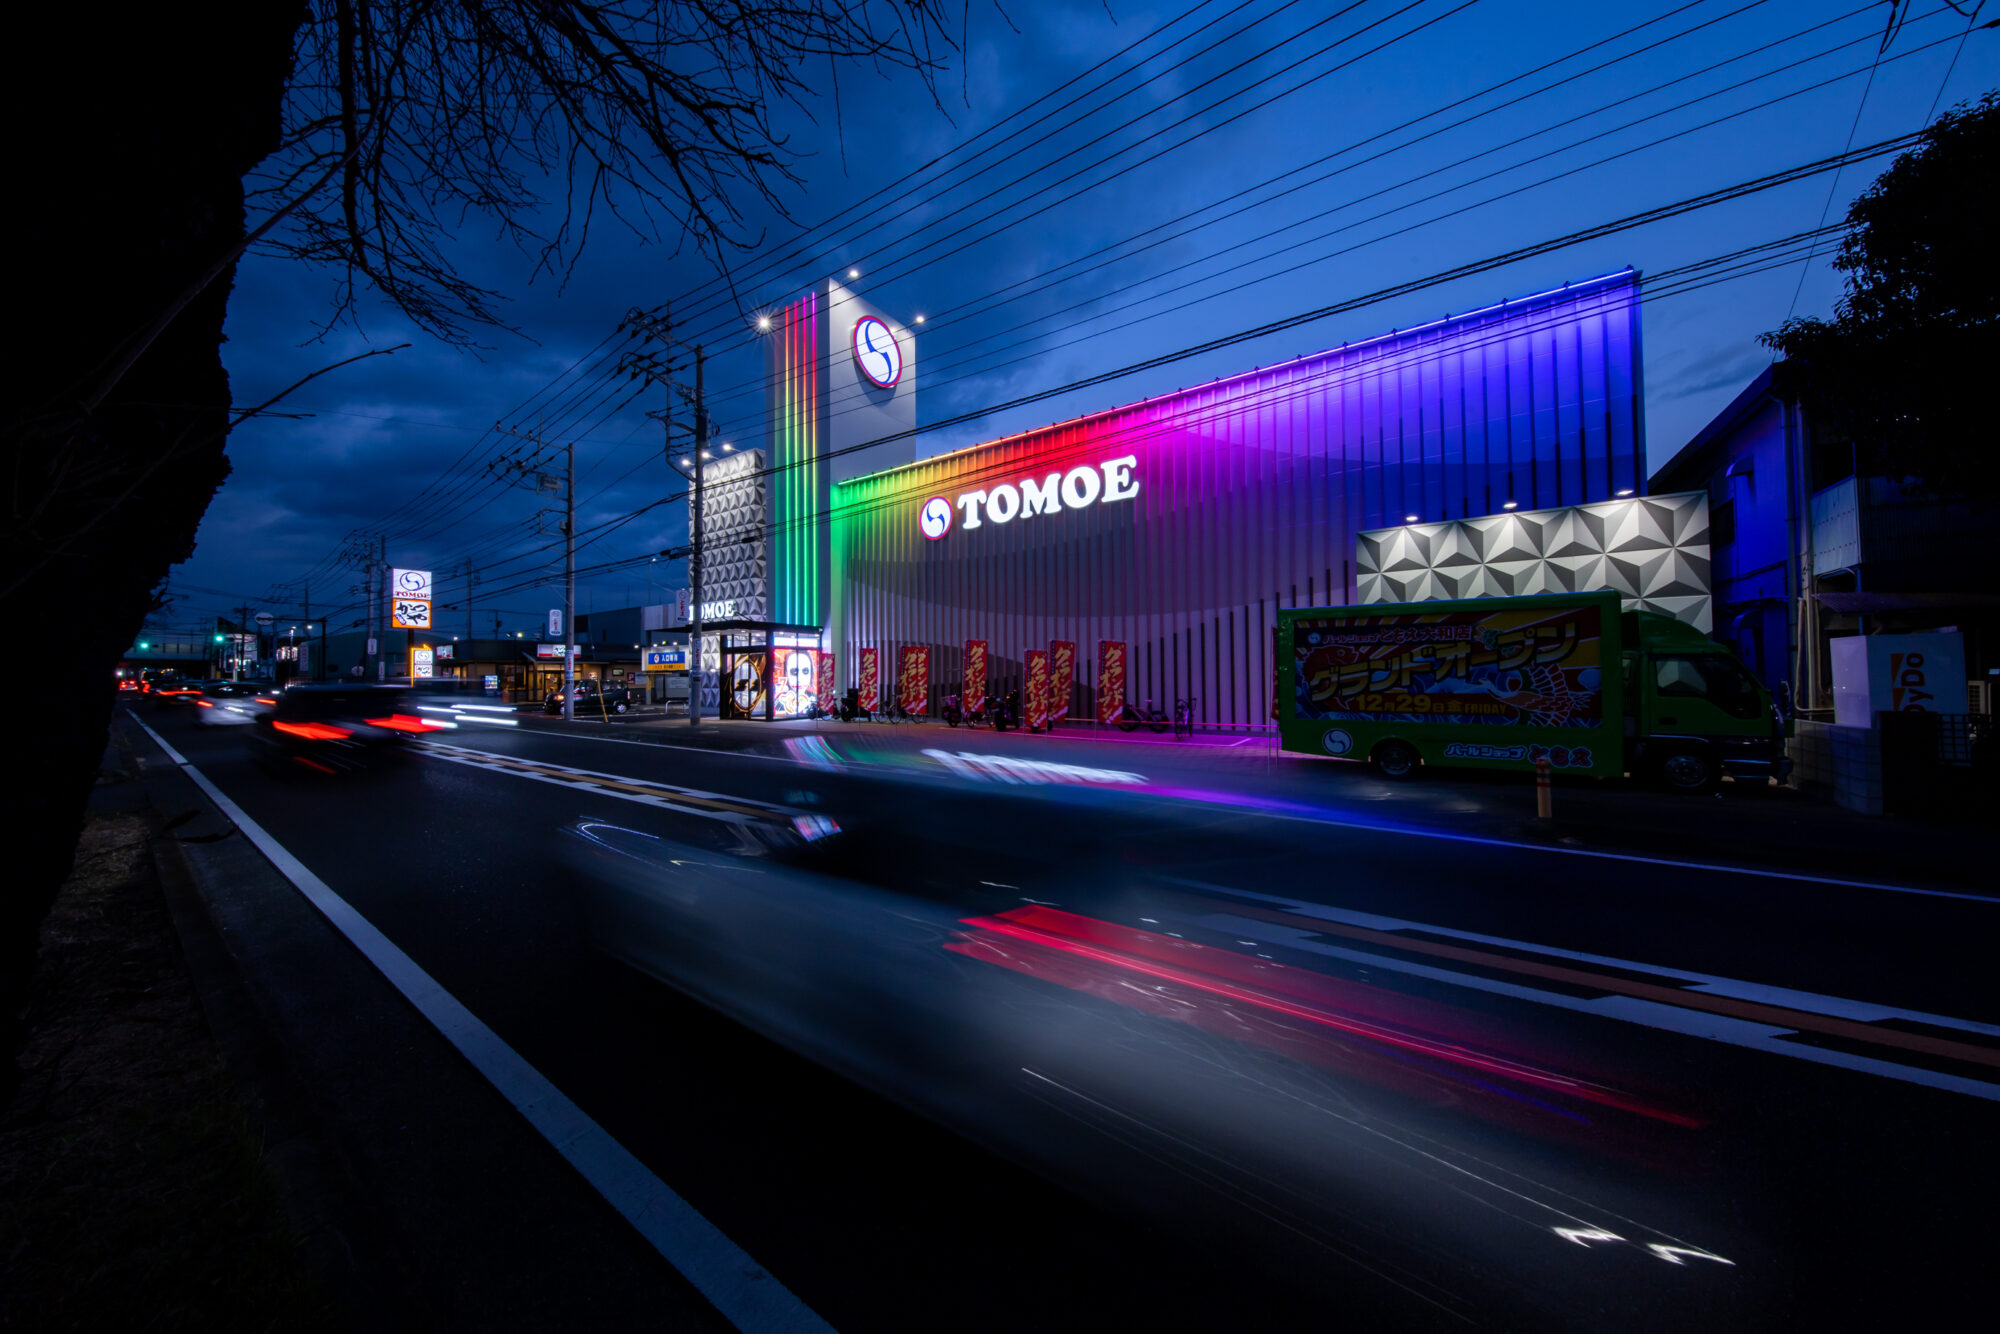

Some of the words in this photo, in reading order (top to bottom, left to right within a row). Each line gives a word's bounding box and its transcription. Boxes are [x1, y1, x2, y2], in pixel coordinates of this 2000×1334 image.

[957, 454, 1140, 530] TOMOE
[1310, 622, 1578, 702] グランドオープン
[1465, 703, 1507, 714] FRIDAY
